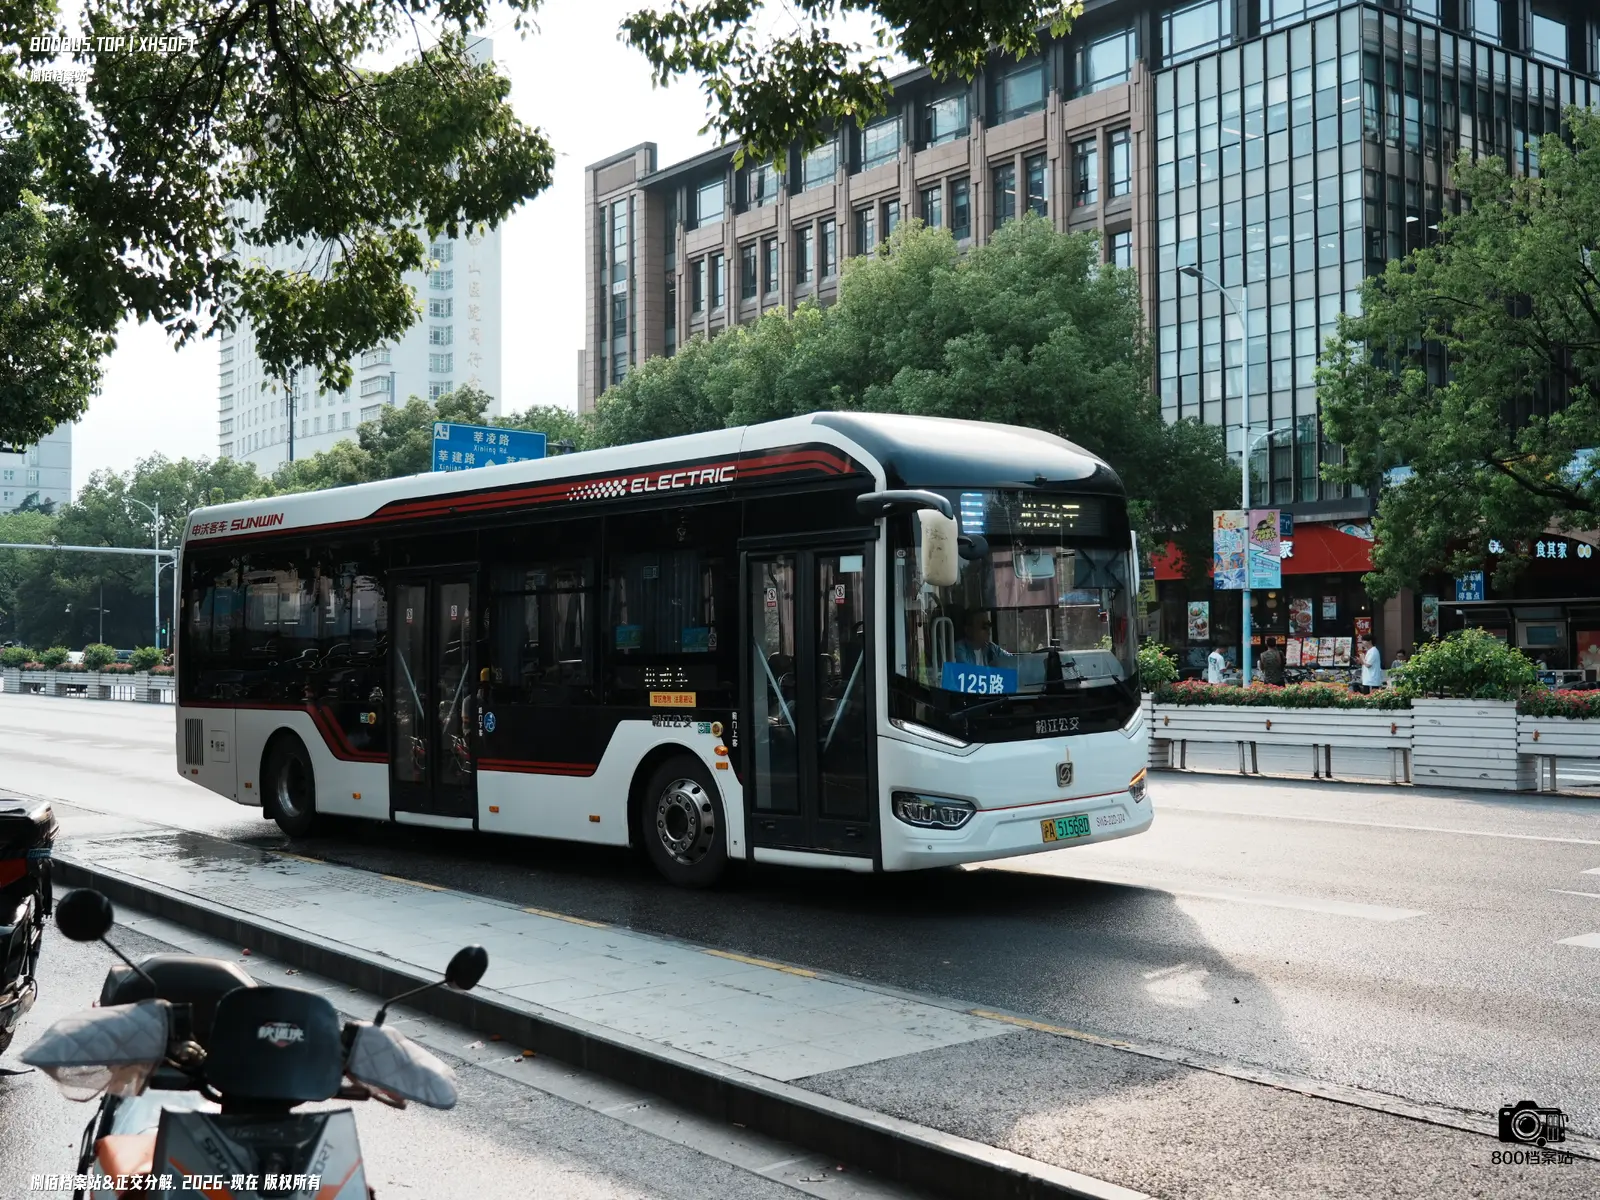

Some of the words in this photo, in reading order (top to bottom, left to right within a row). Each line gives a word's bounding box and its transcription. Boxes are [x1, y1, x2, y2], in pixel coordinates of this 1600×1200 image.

[473, 431, 510, 446] 莘凌路
[438, 449, 475, 464] 莘建路
[473, 445, 497, 455] Xinling
[630, 465, 735, 493] ELECTRIC
[191, 520, 227, 536] 申沃客车
[230, 512, 284, 532] SUNWIN
[1535, 540, 1568, 559] 食其家
[958, 672, 1004, 694] 125路
[652, 714, 693, 728] 松江公交
[1035, 716, 1080, 734] 松江公交
